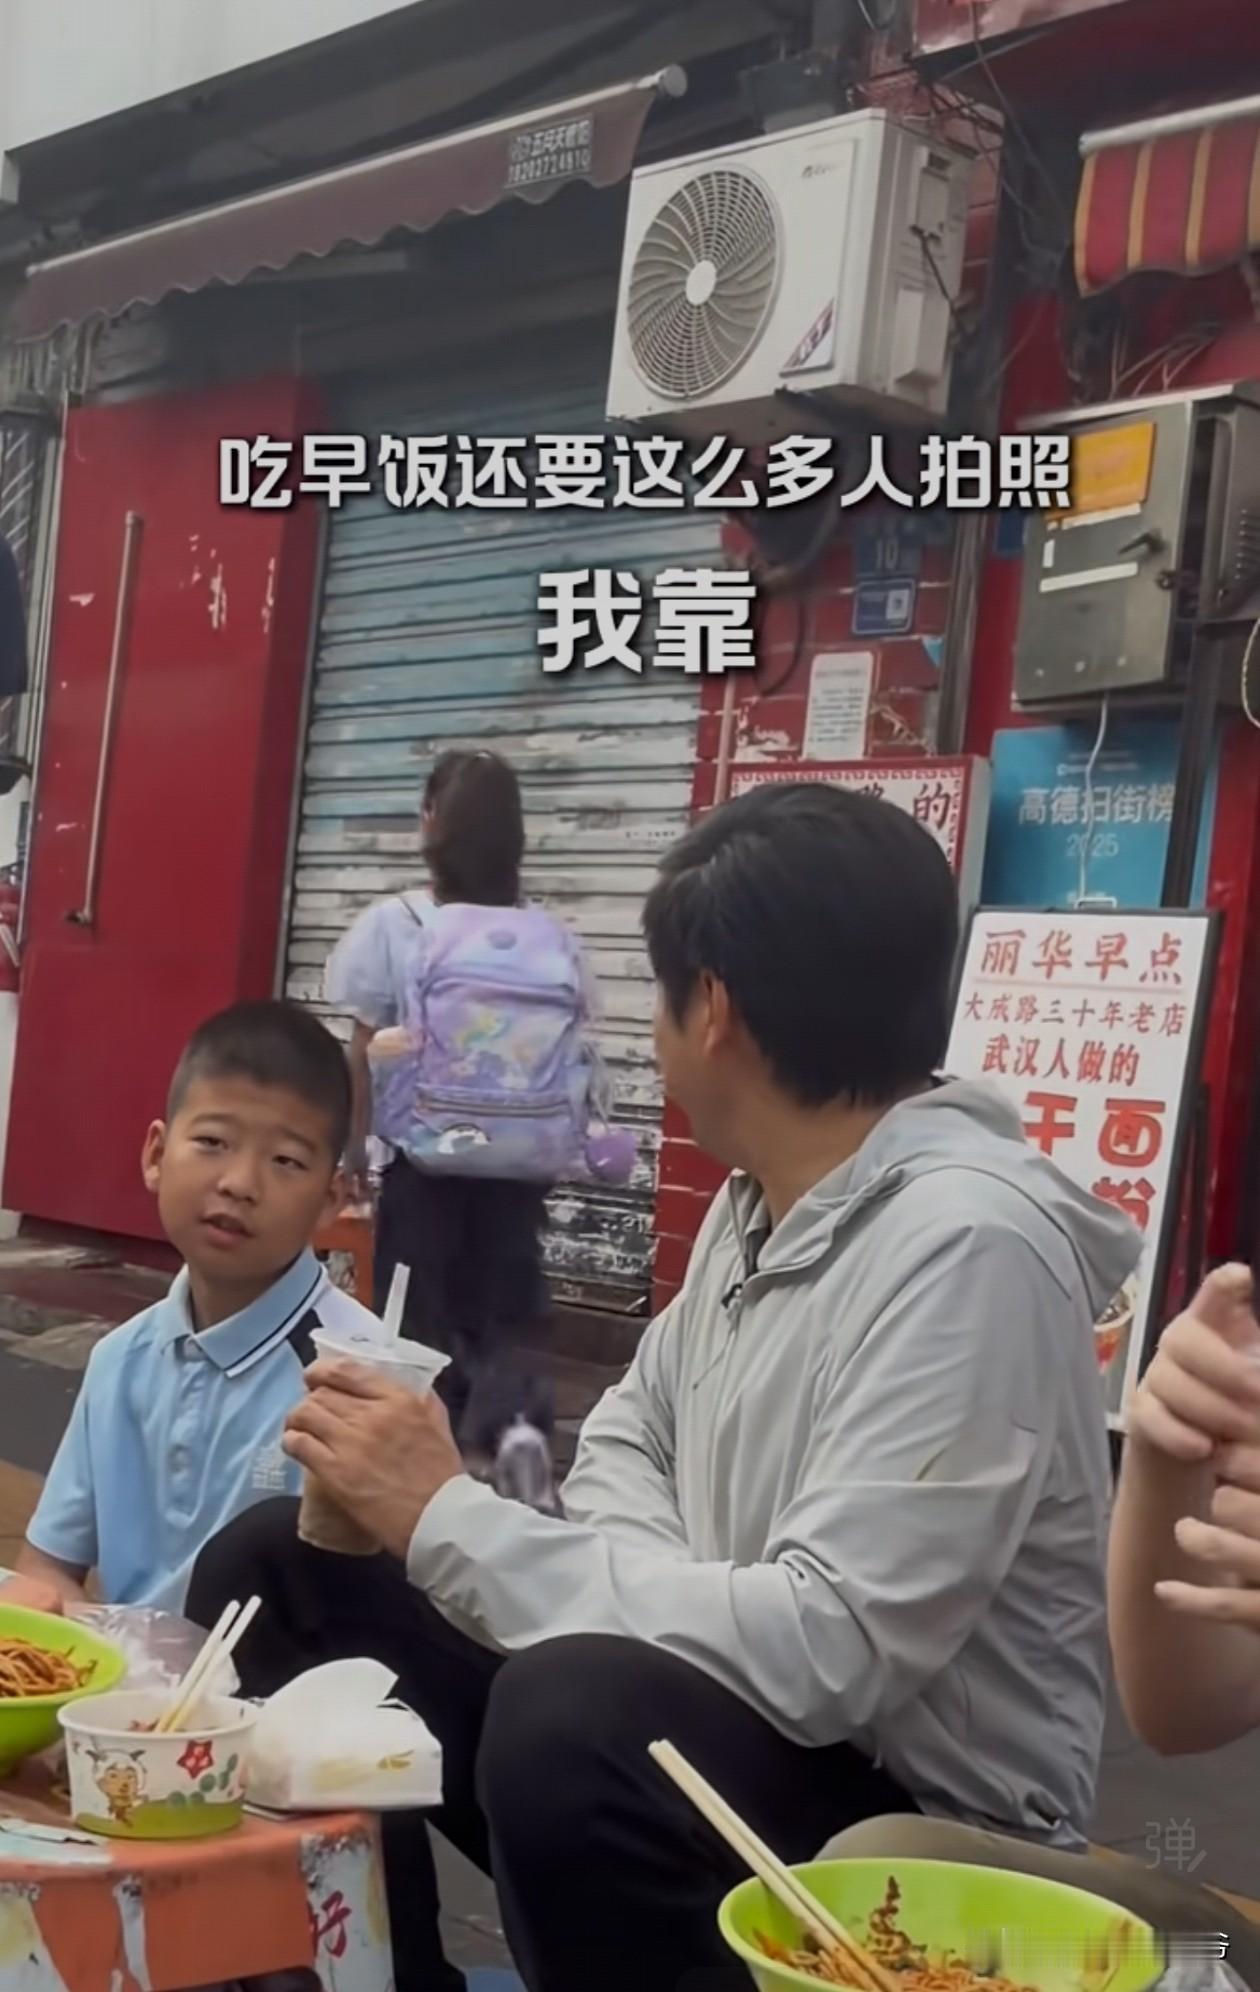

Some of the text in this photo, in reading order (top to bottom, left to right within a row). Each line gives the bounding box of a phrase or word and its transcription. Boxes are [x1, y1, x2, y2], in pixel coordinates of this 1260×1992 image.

[980, 929, 1182, 984] 丽华早点
[964, 991, 1188, 1036] 大成路三十年老店
[981, 1033, 1140, 1087] 武汉人做的
